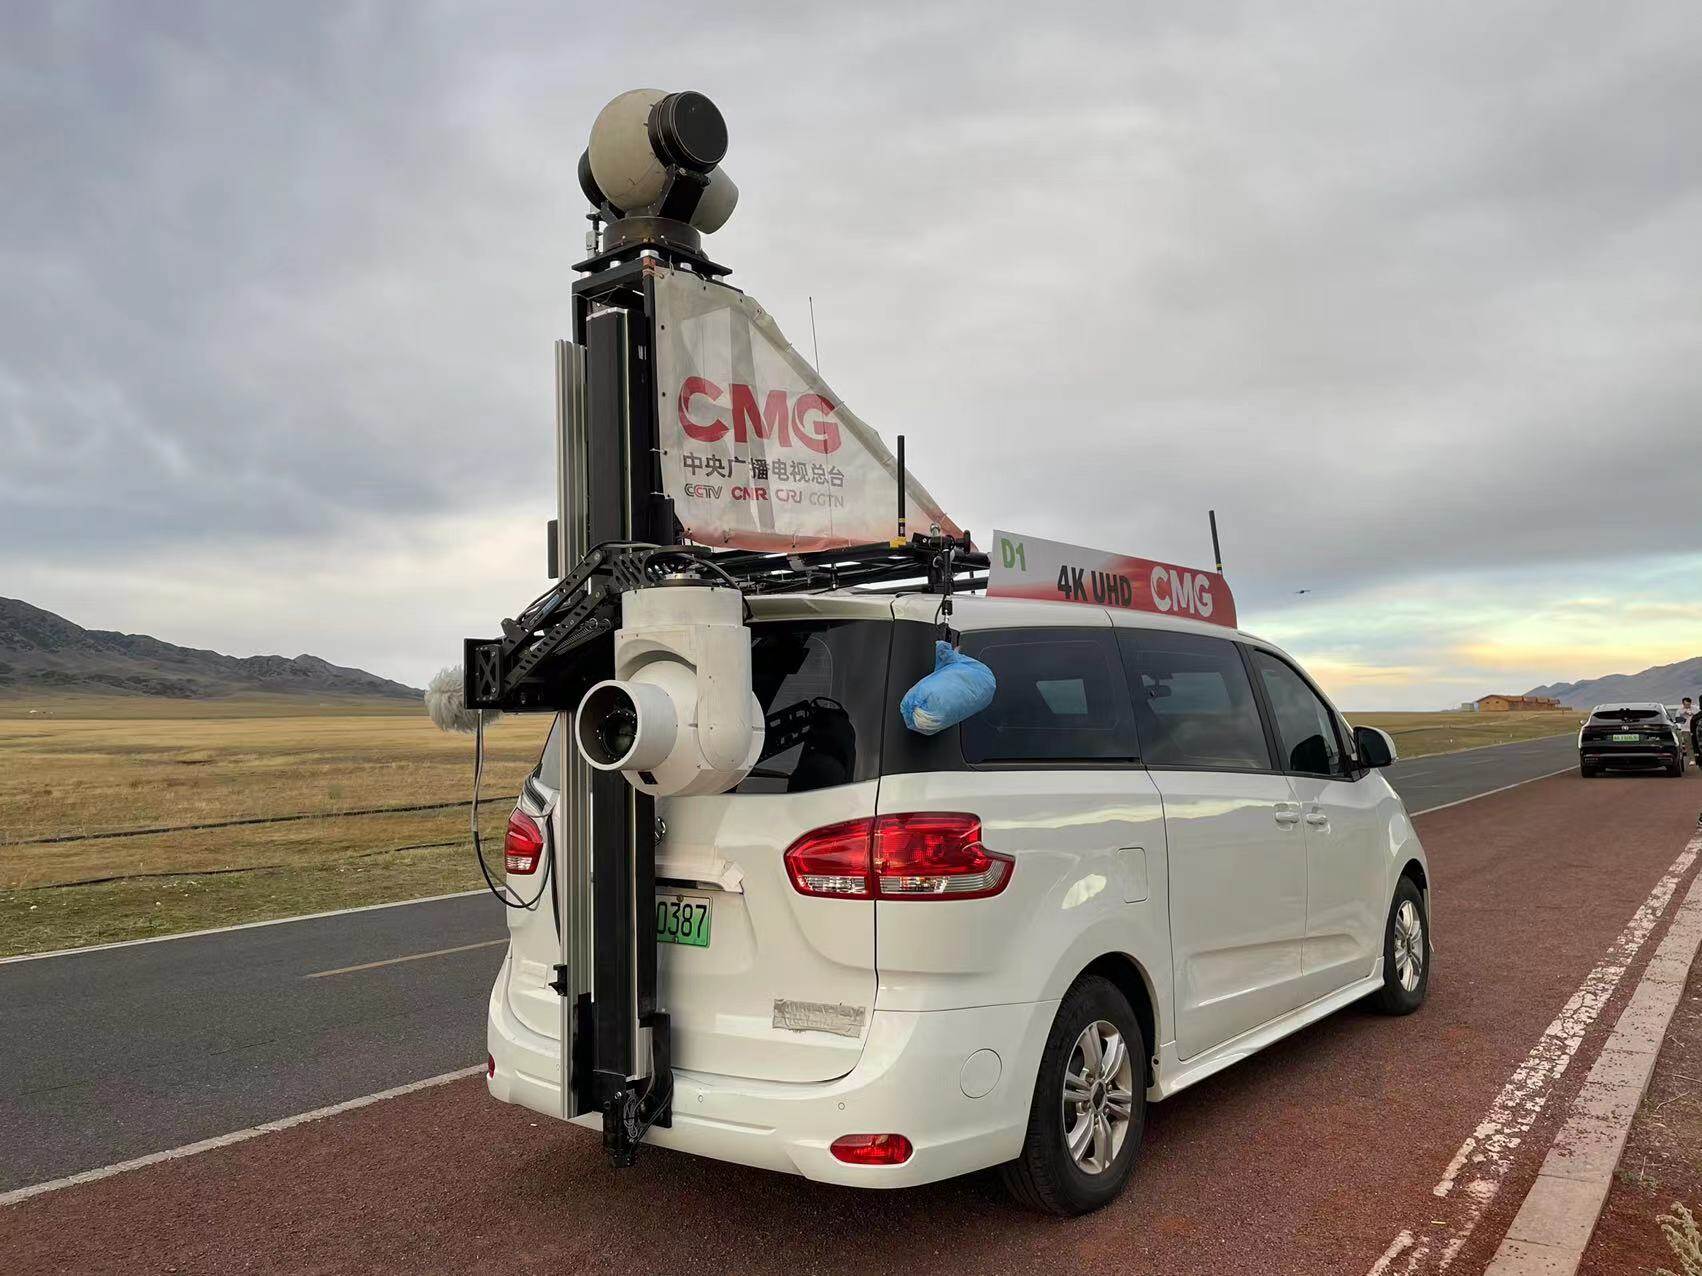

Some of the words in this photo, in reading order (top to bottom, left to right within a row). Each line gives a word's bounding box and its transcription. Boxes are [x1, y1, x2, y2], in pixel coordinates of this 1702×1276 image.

[678, 376, 842, 454] CMG
[683, 452, 845, 488] 中央广播电视总台
[684, 483, 722, 499] CCTV
[731, 486, 768, 501] CNR
[1000, 538, 1026, 572] D1
[1057, 565, 1088, 600] 4K
[1091, 570, 1132, 608] UHD
[1150, 565, 1213, 617] CMG
[656, 901, 708, 939] 0387
